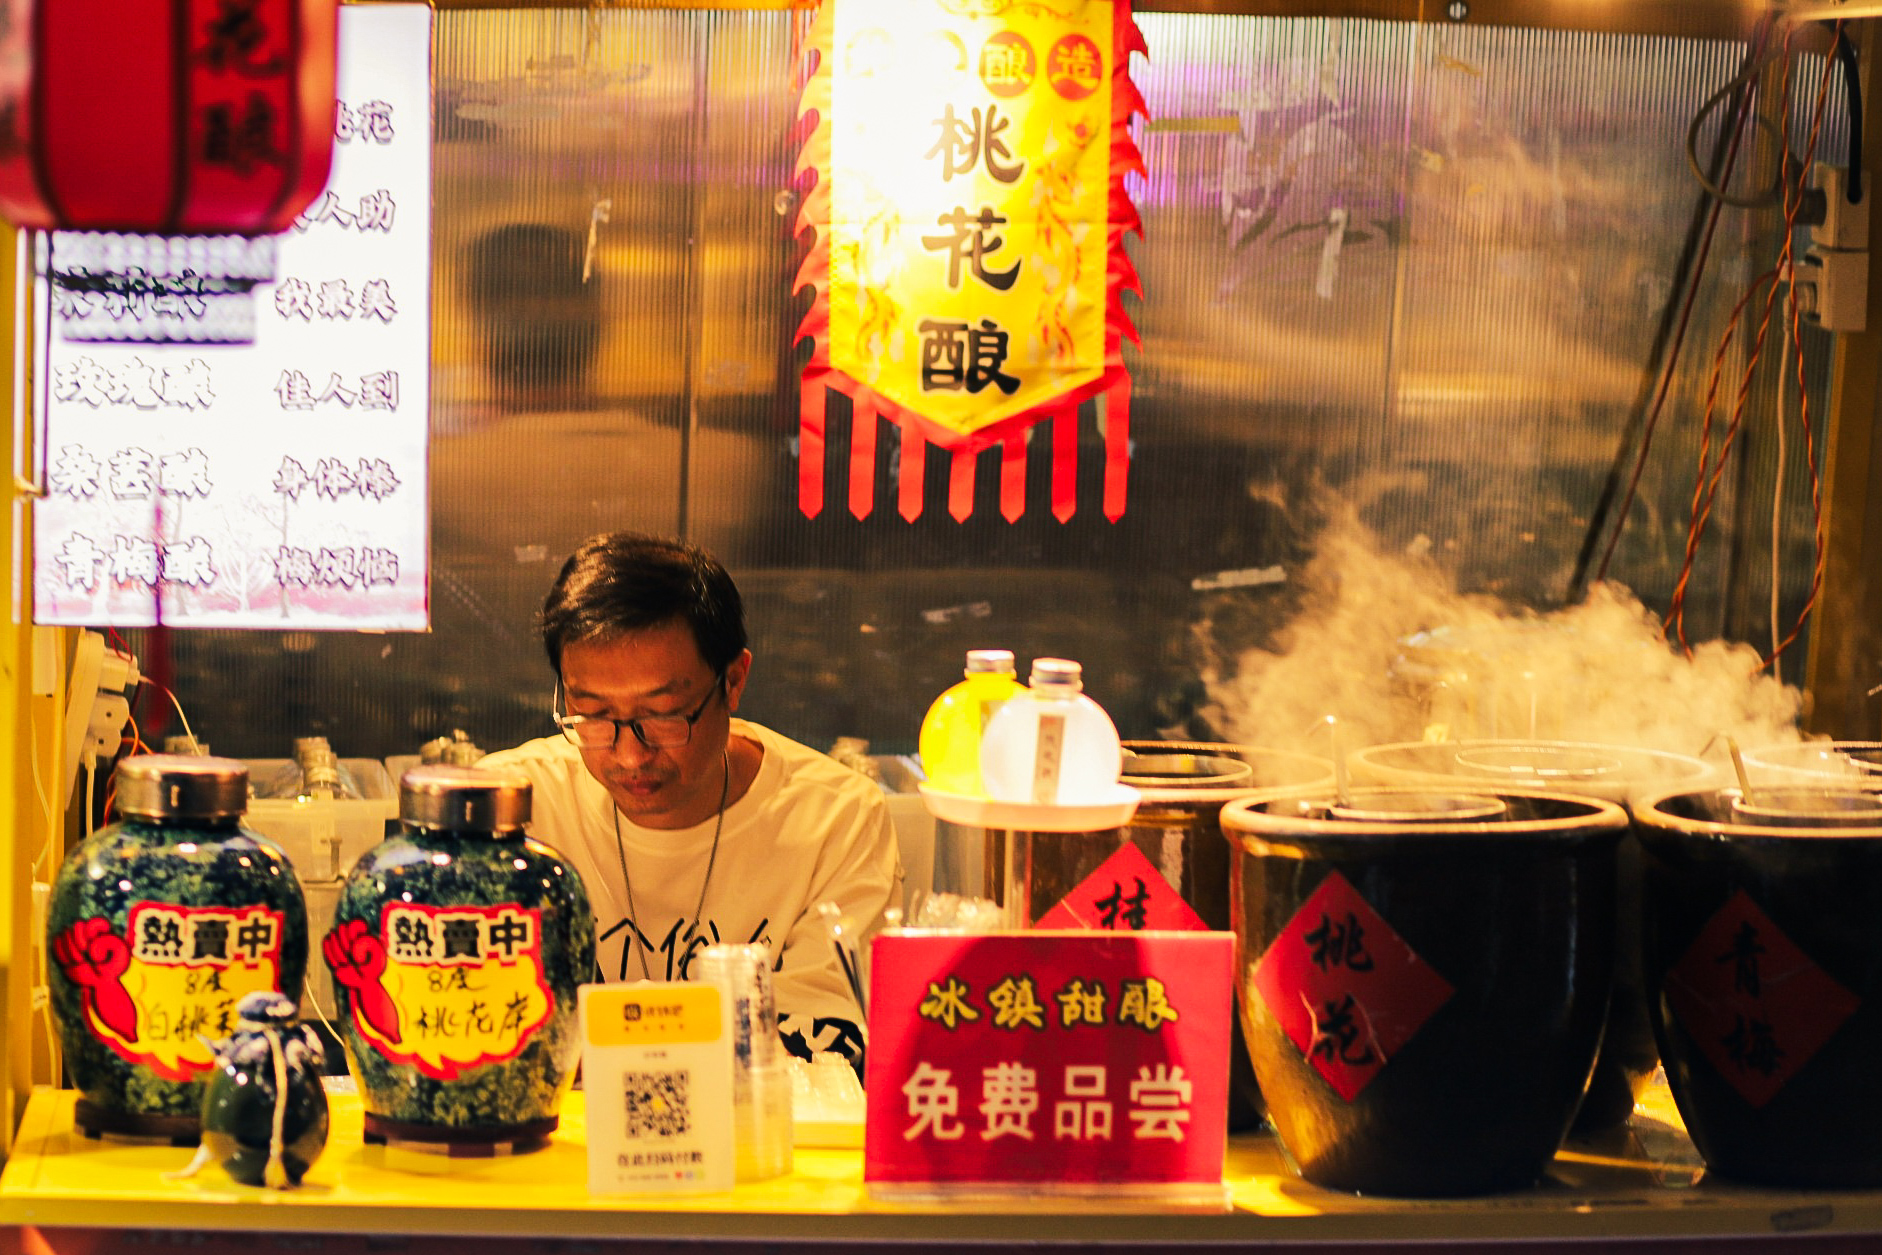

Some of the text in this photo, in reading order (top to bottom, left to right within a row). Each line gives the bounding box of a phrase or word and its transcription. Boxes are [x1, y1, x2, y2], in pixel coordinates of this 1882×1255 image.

[292, 189, 397, 233] 人助
[918, 103, 1025, 396] 桃花酿
[274, 370, 400, 412] 佳人到
[273, 455, 401, 502] 身体棒
[137, 911, 276, 963] 熱賣中
[391, 911, 531, 963] 熱賣中
[1302, 912, 1375, 1067] 桃花
[1715, 920, 1786, 1077] 青梅
[902, 1061, 1193, 1142] 免费品尝
